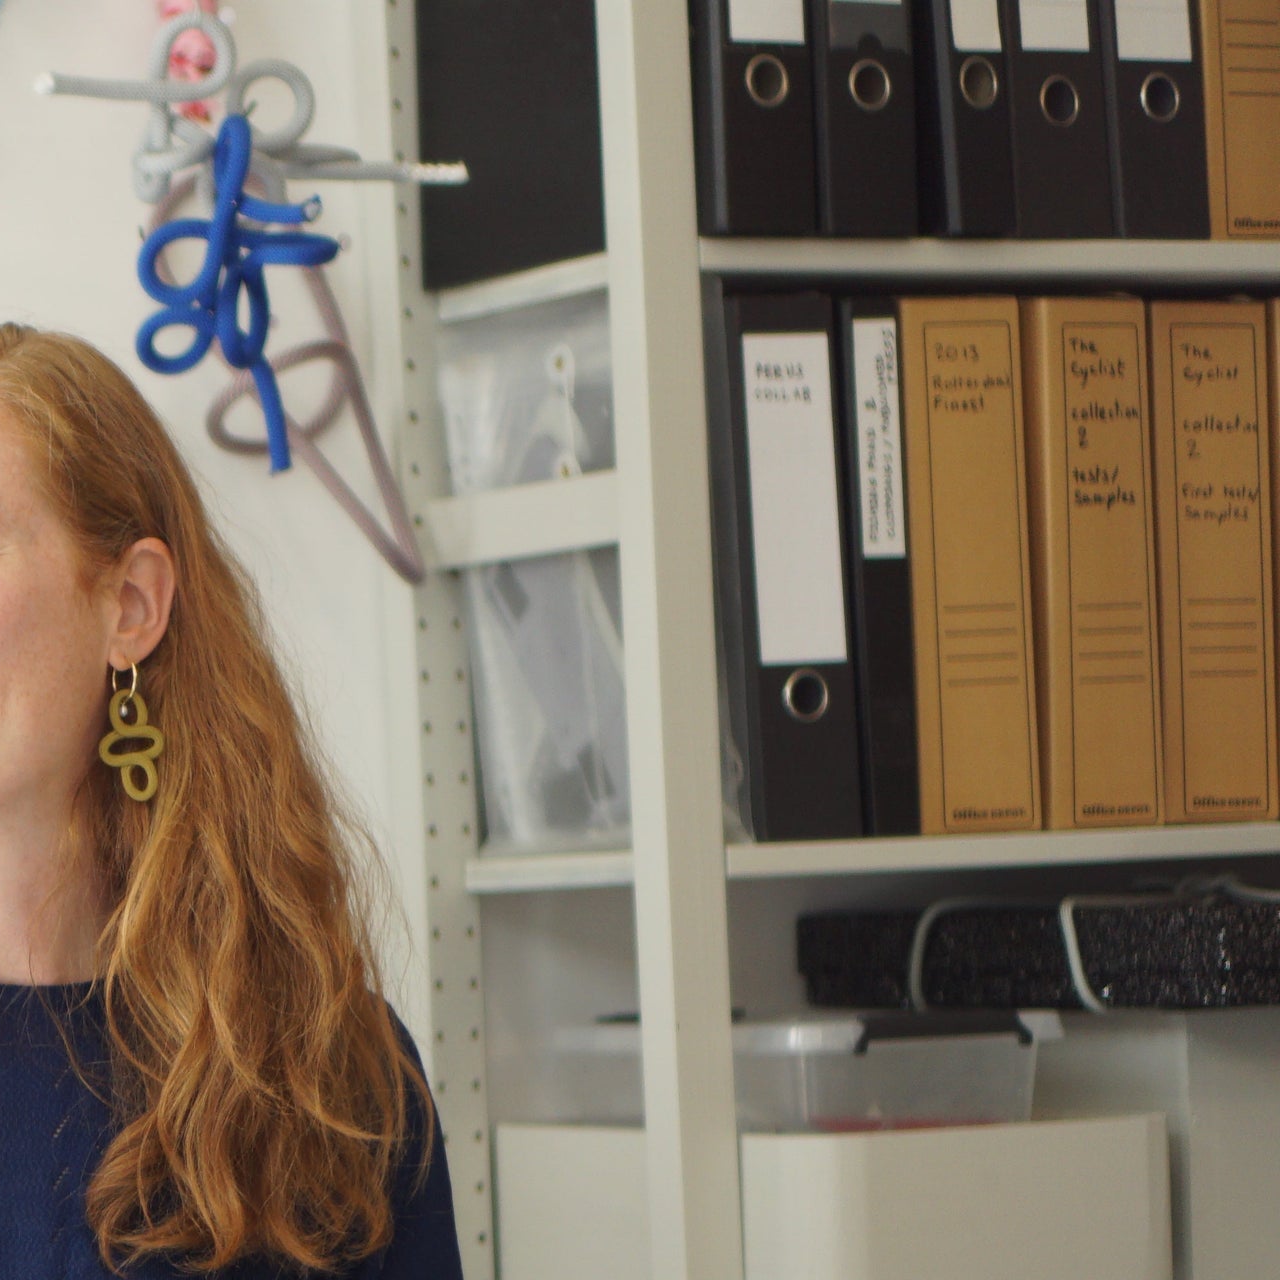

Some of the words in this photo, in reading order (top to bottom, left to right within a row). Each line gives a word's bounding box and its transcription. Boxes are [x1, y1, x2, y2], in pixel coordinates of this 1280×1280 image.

[934, 342, 980, 361] 2013
[1069, 336, 1098, 353] The
[1180, 343, 1212, 361] The
[1070, 357, 1125, 388] Cyclist
